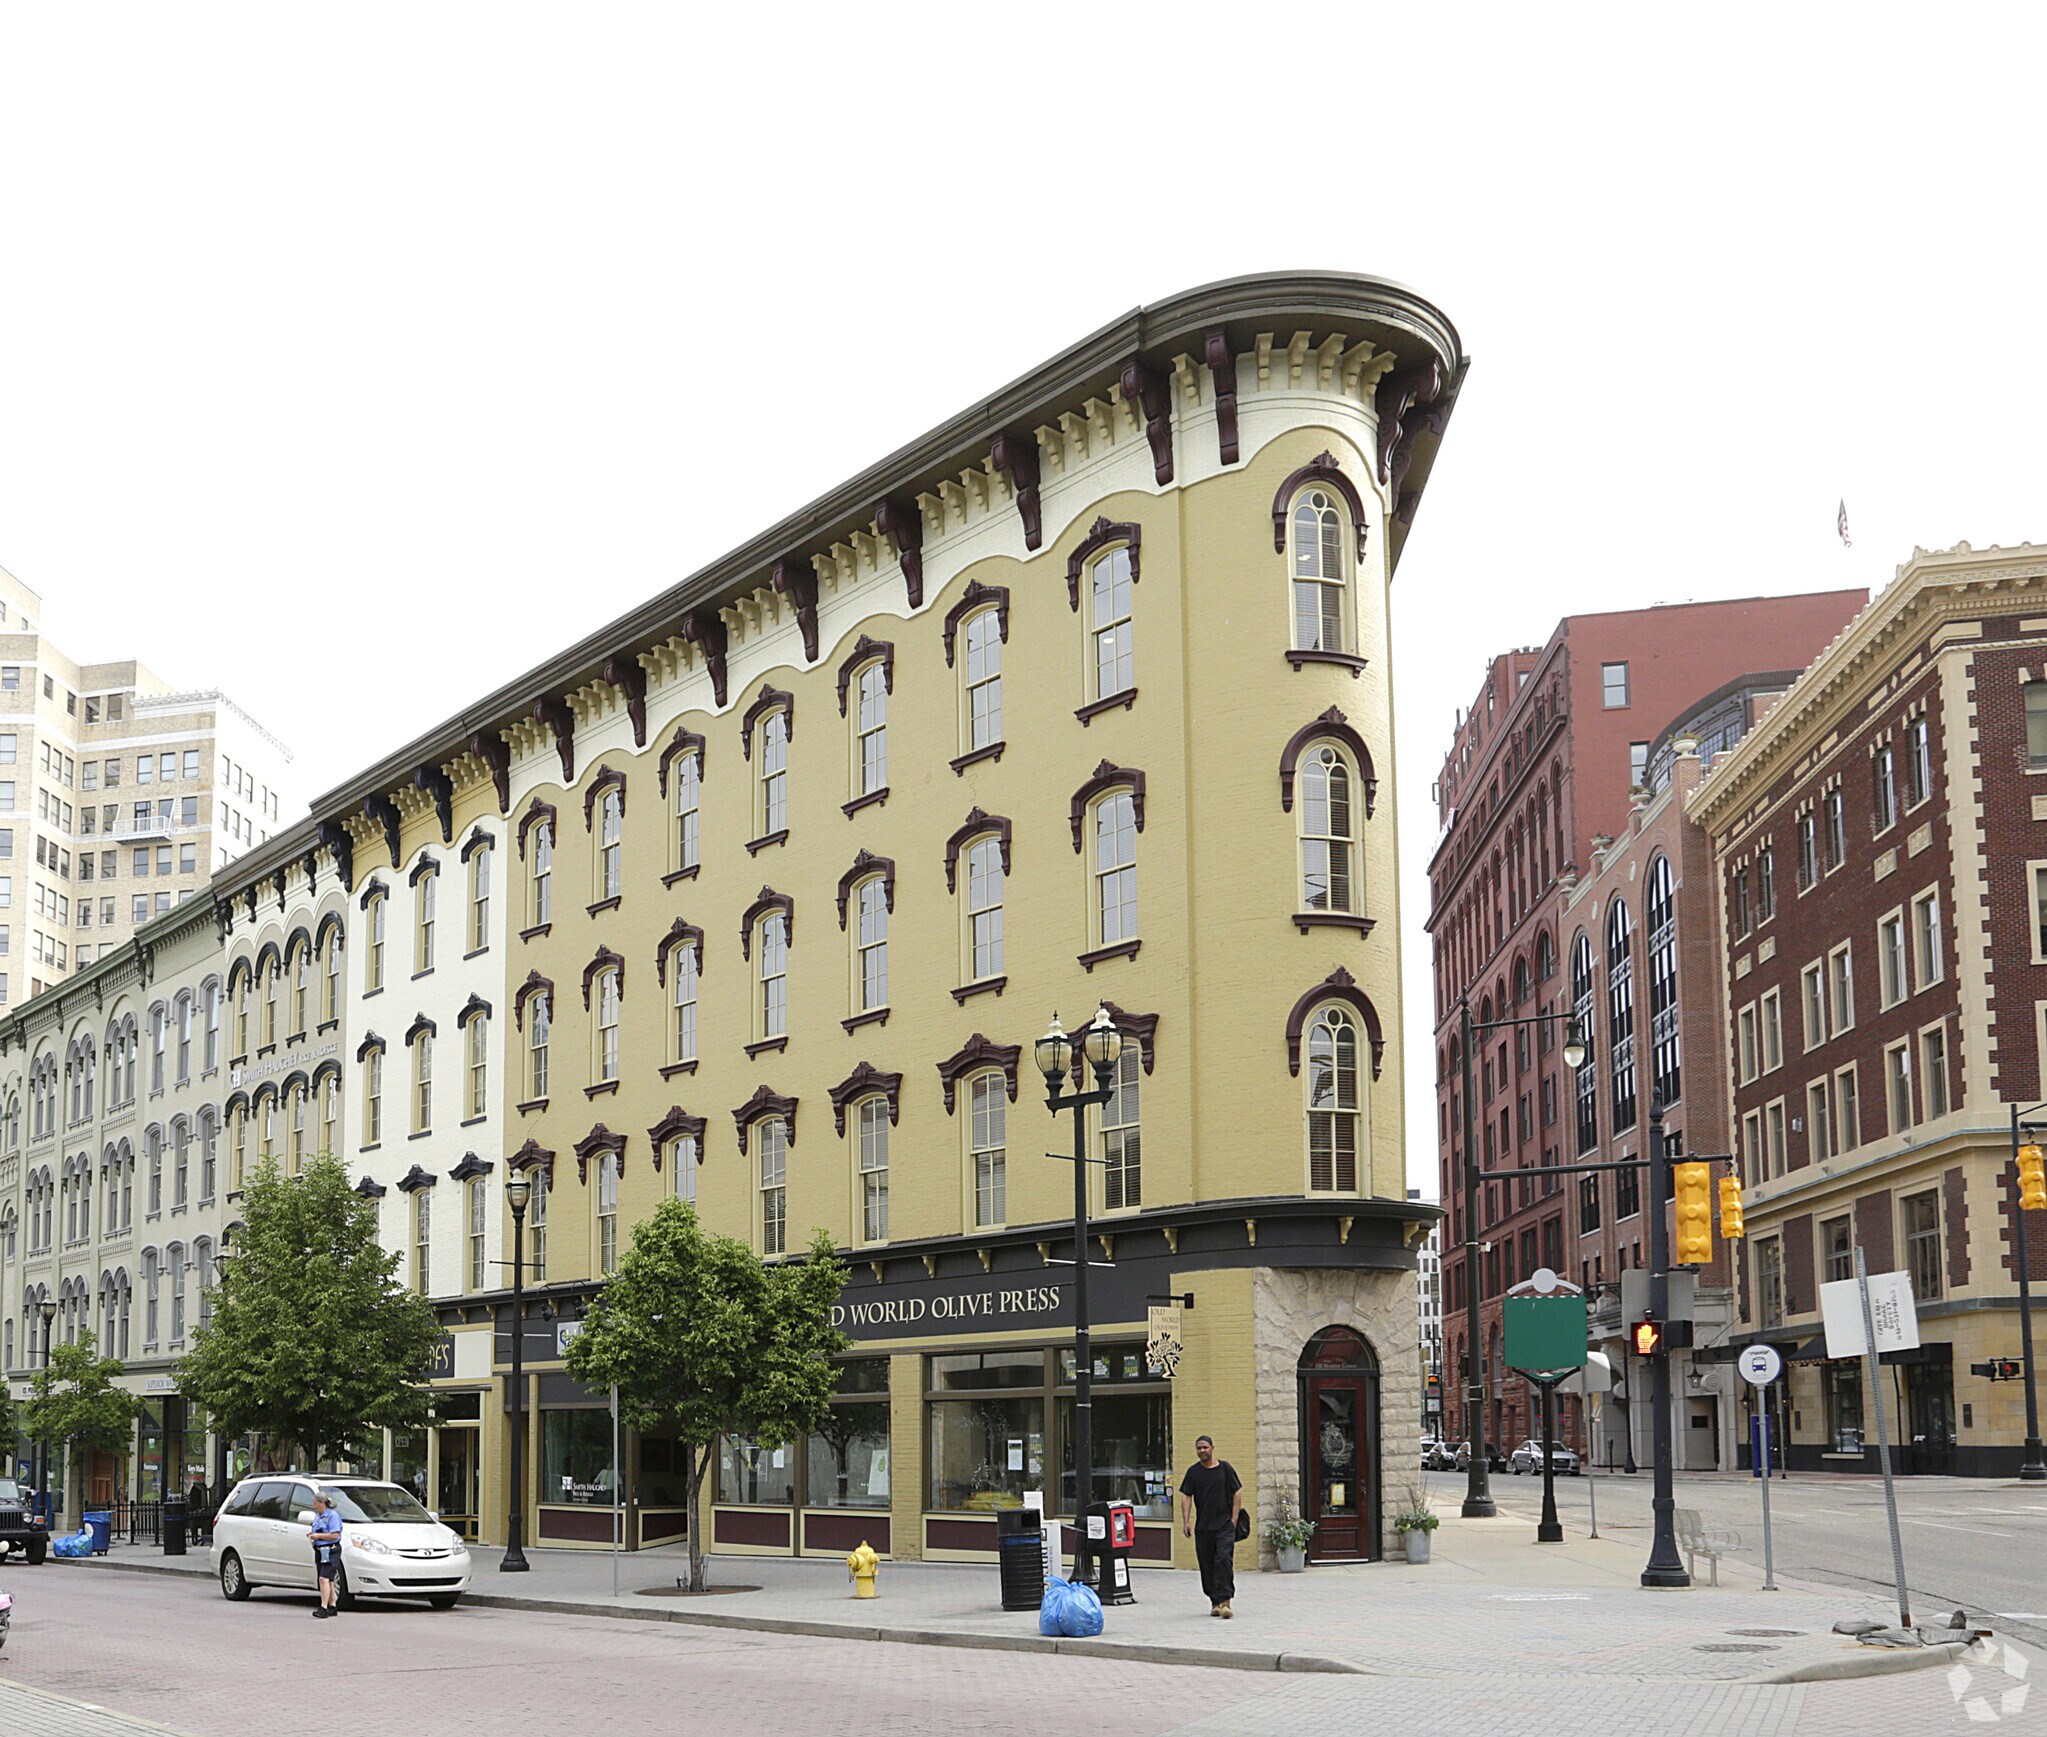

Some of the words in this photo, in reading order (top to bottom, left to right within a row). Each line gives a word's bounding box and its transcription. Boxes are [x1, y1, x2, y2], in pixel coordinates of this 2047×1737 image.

[242, 1066, 264, 1084] SMITH
[265, 1052, 299, 1075] HAUGHEY
[849, 1298, 926, 1326] WORLD
[931, 1292, 994, 1319] OLIVE
[998, 1286, 1060, 1313] PRESS
